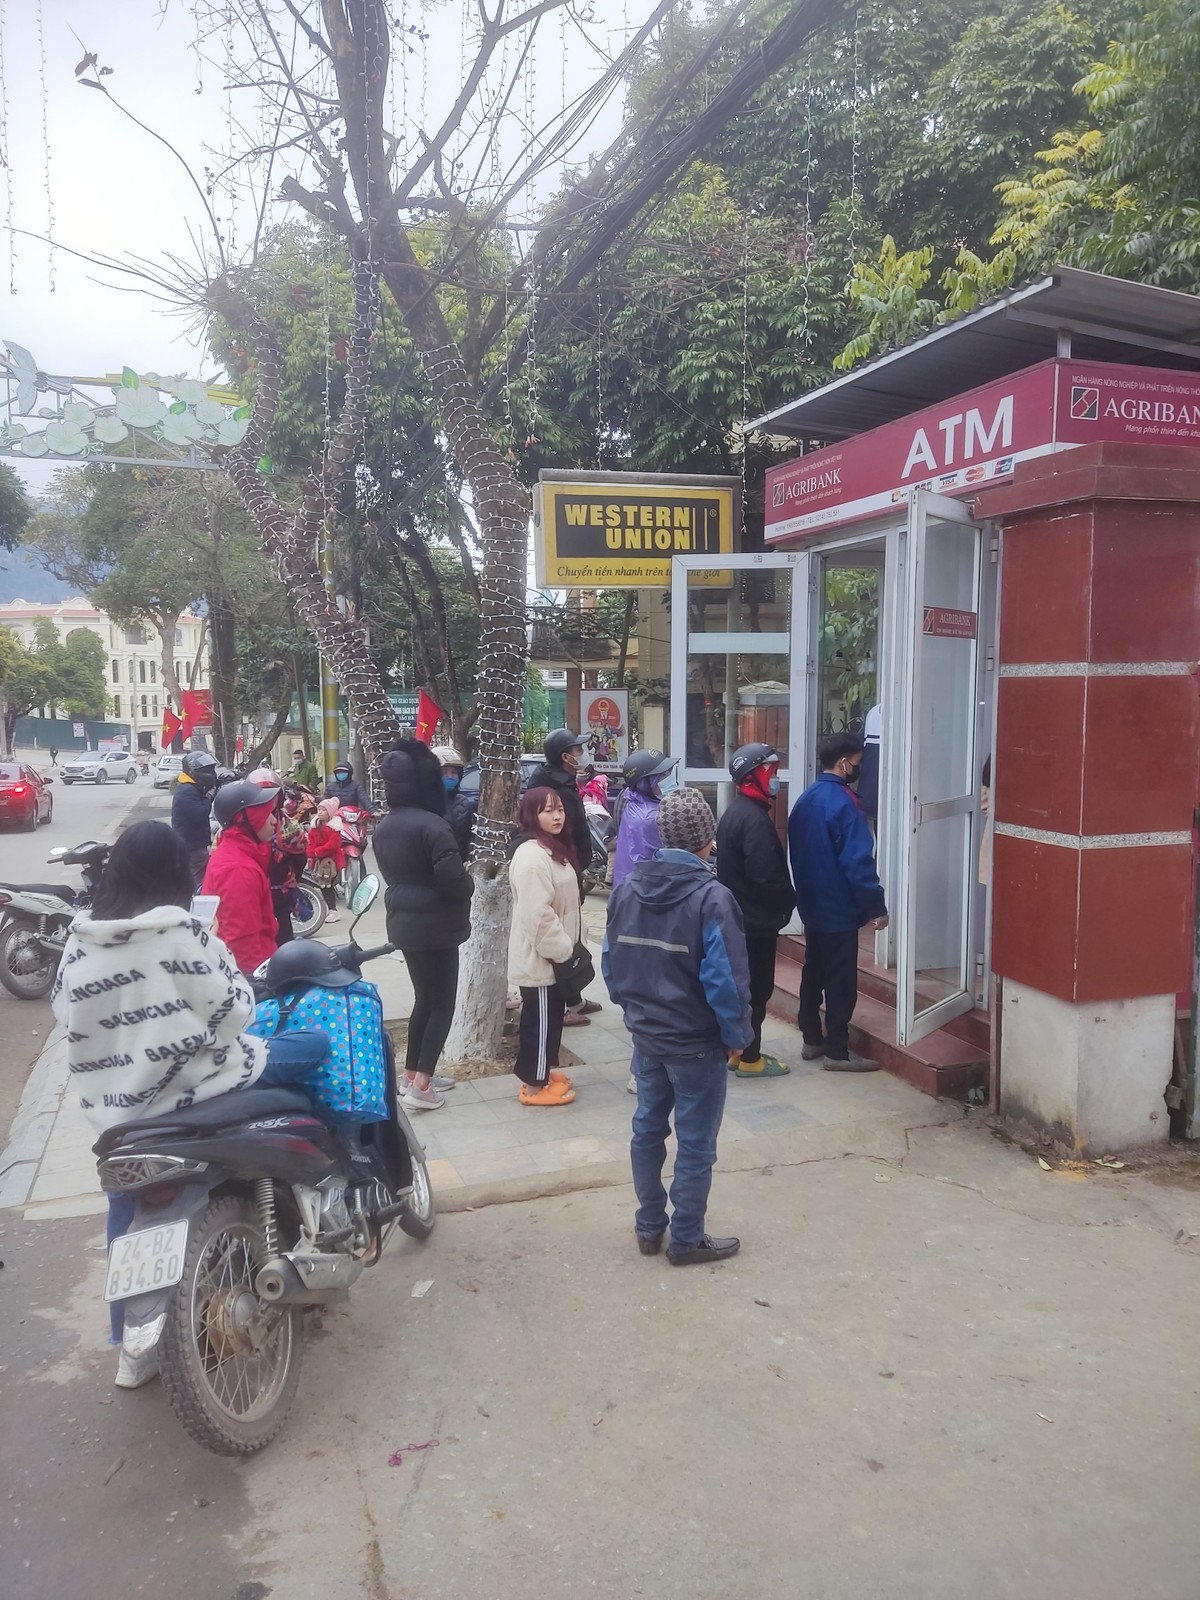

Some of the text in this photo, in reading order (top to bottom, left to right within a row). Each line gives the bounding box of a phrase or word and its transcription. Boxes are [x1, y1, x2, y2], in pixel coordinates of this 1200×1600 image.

[900, 394, 1014, 480] ATM
[785, 467, 841, 501] AGRIBANK
[564, 504, 690, 527] WESTERN
[605, 528, 690, 550] UNION
[557, 565, 592, 579] Chuyển
[615, 567, 643, 577] nhanh
[646, 568, 663, 576] trên
[939, 612, 971, 627] AGRIBANK
[121, 1228, 175, 1266] 24-B2
[109, 1254, 179, 1297] 834.60
